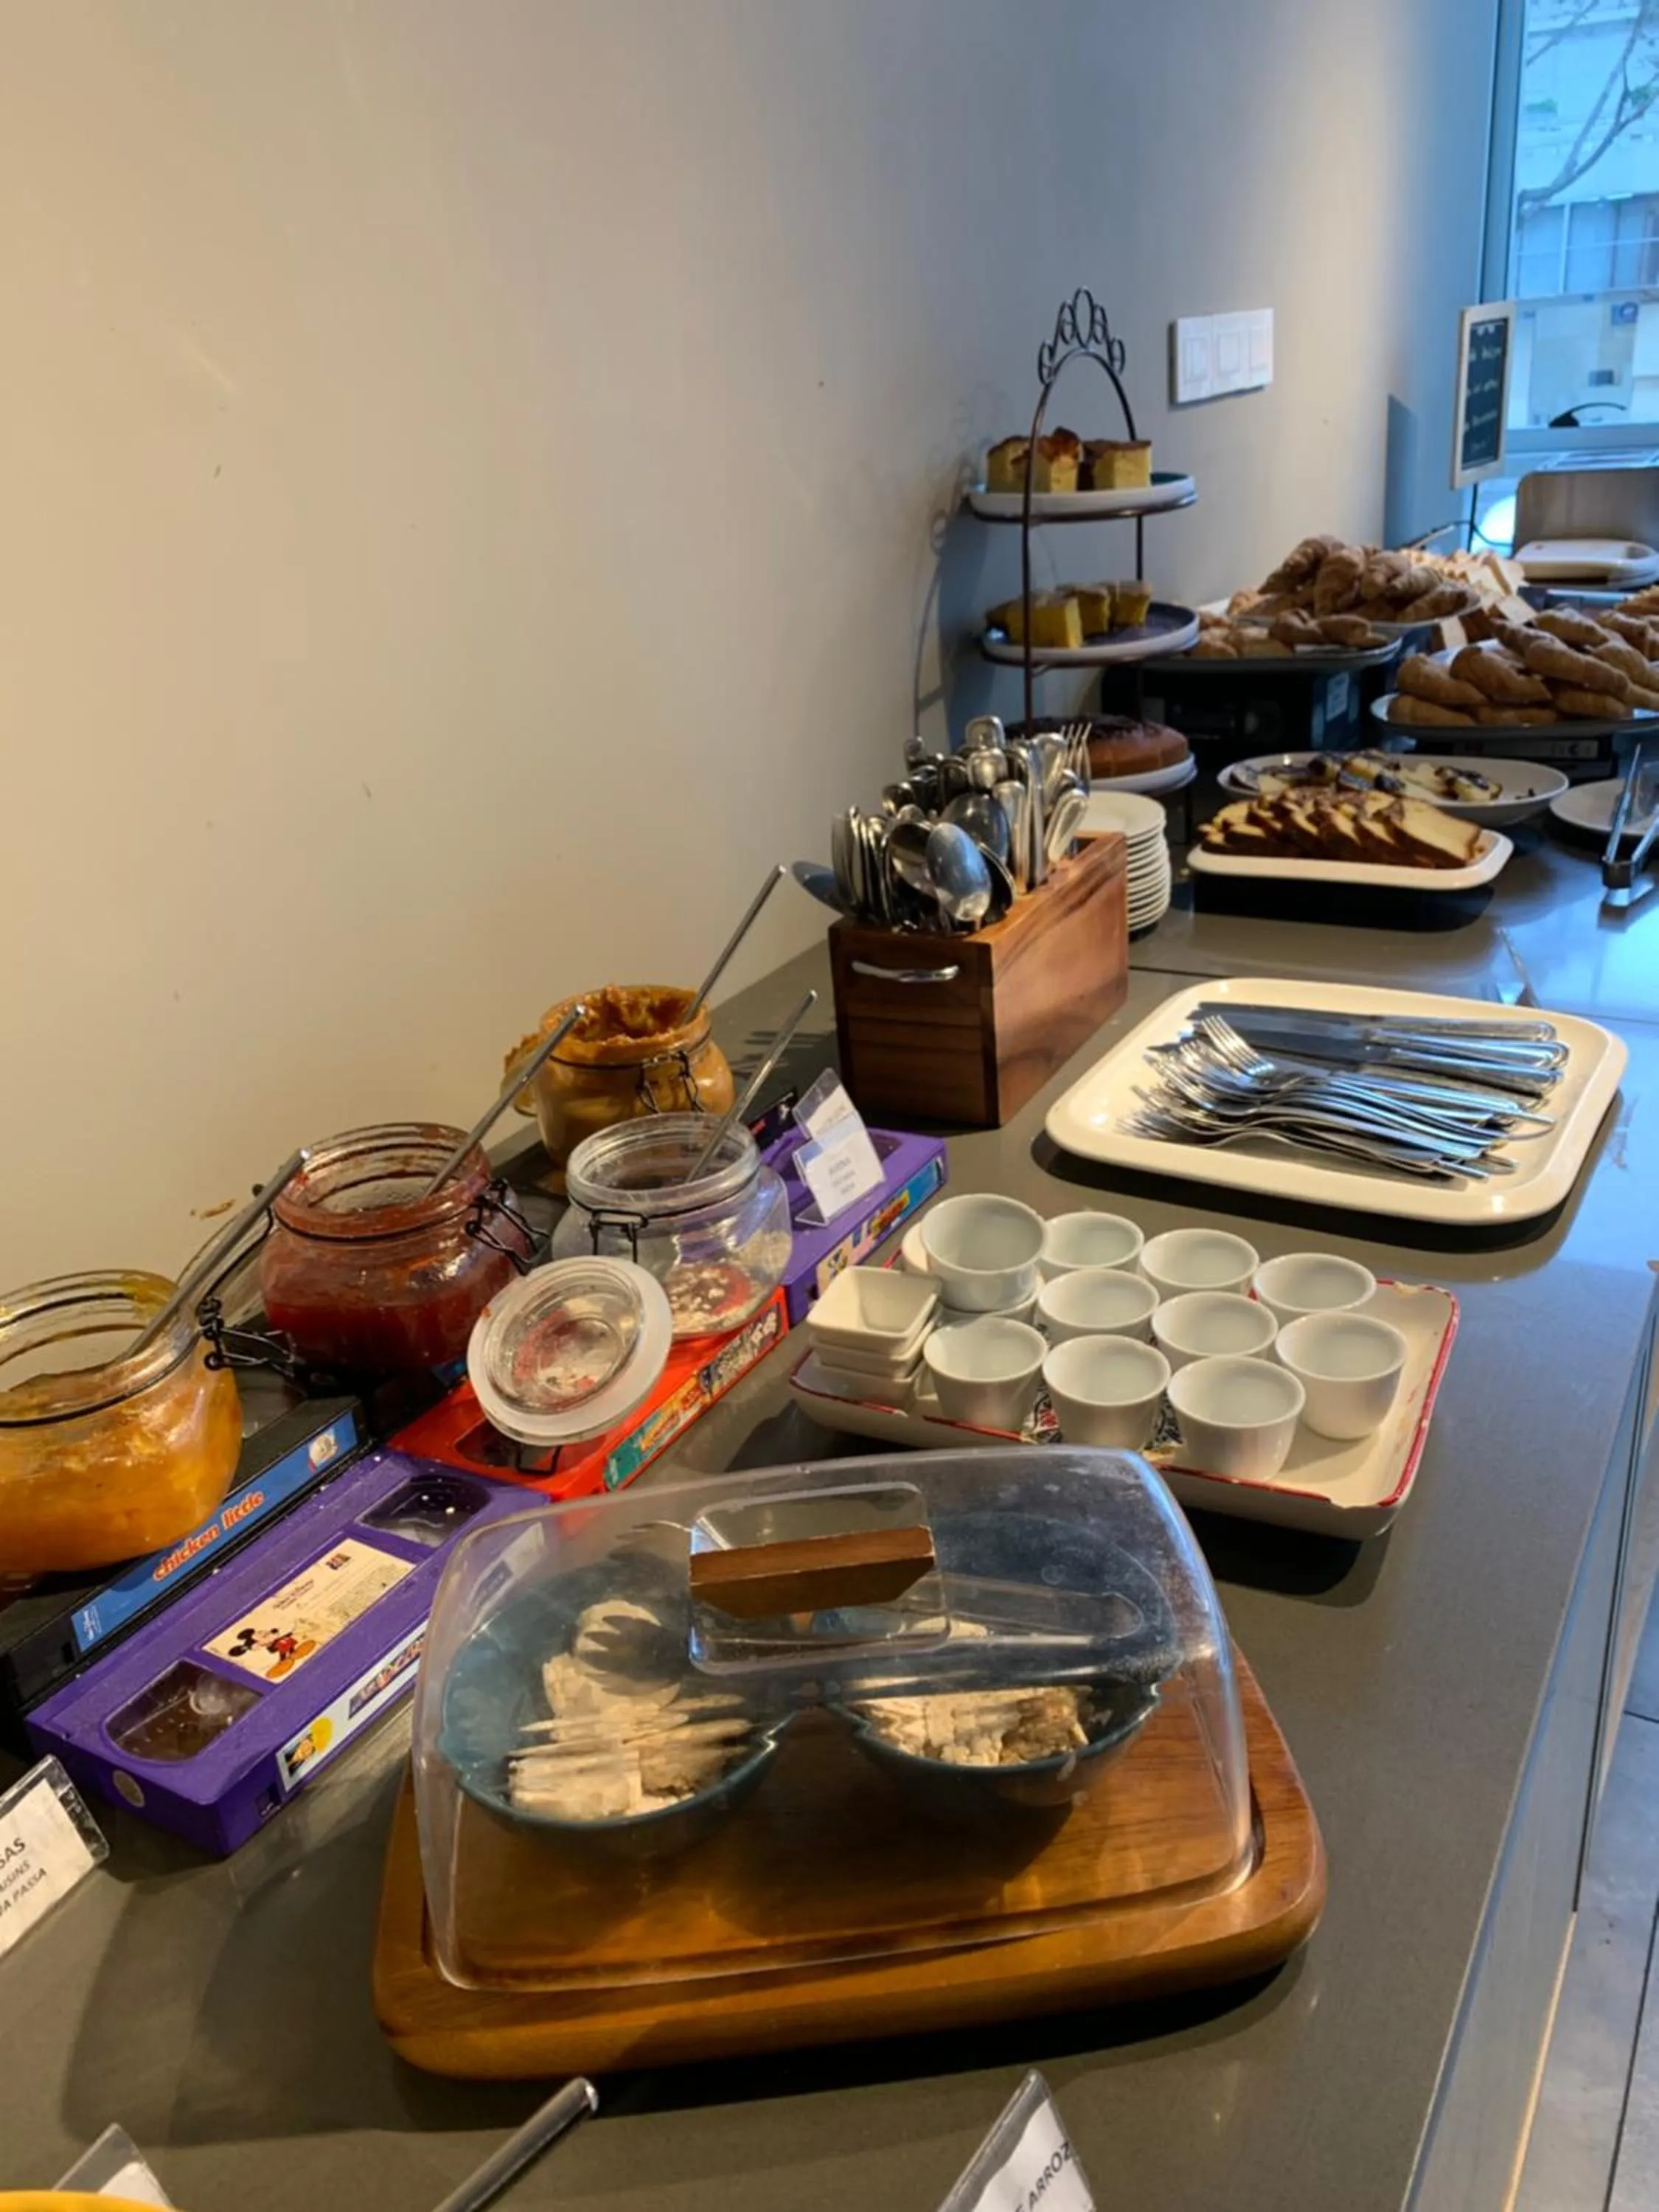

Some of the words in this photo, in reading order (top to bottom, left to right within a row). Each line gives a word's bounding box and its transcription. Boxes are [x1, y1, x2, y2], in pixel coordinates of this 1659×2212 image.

[153, 1523, 220, 1581] chicken
[221, 1491, 265, 1531] little
[1029, 2140, 1071, 2212] ARROZ
